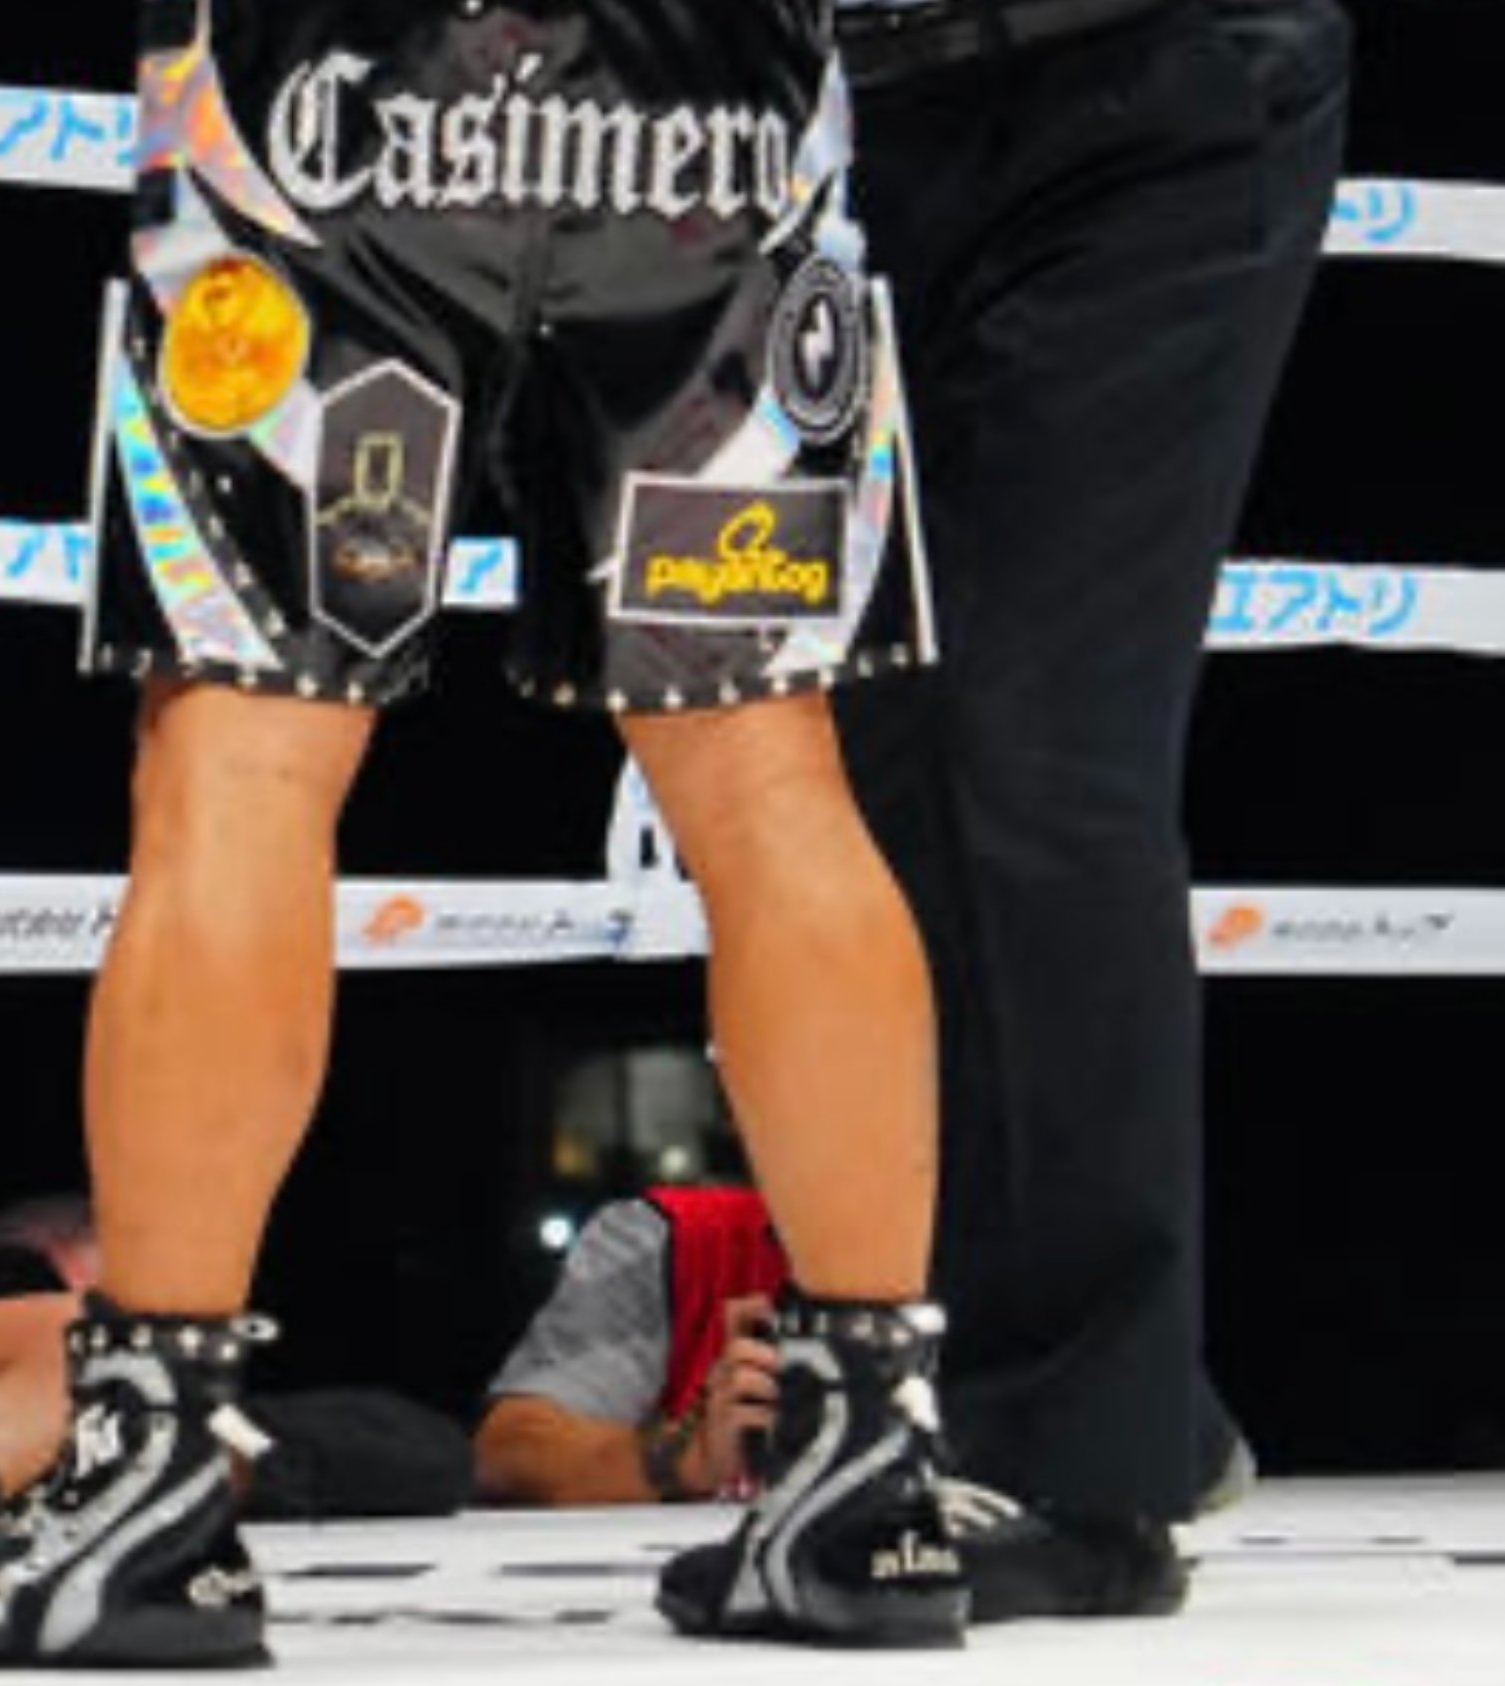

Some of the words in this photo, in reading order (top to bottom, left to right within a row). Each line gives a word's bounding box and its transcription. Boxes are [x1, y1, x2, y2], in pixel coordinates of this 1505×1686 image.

[268, 51, 788, 218] Casimero
[1208, 568, 1418, 636] エアトリ
